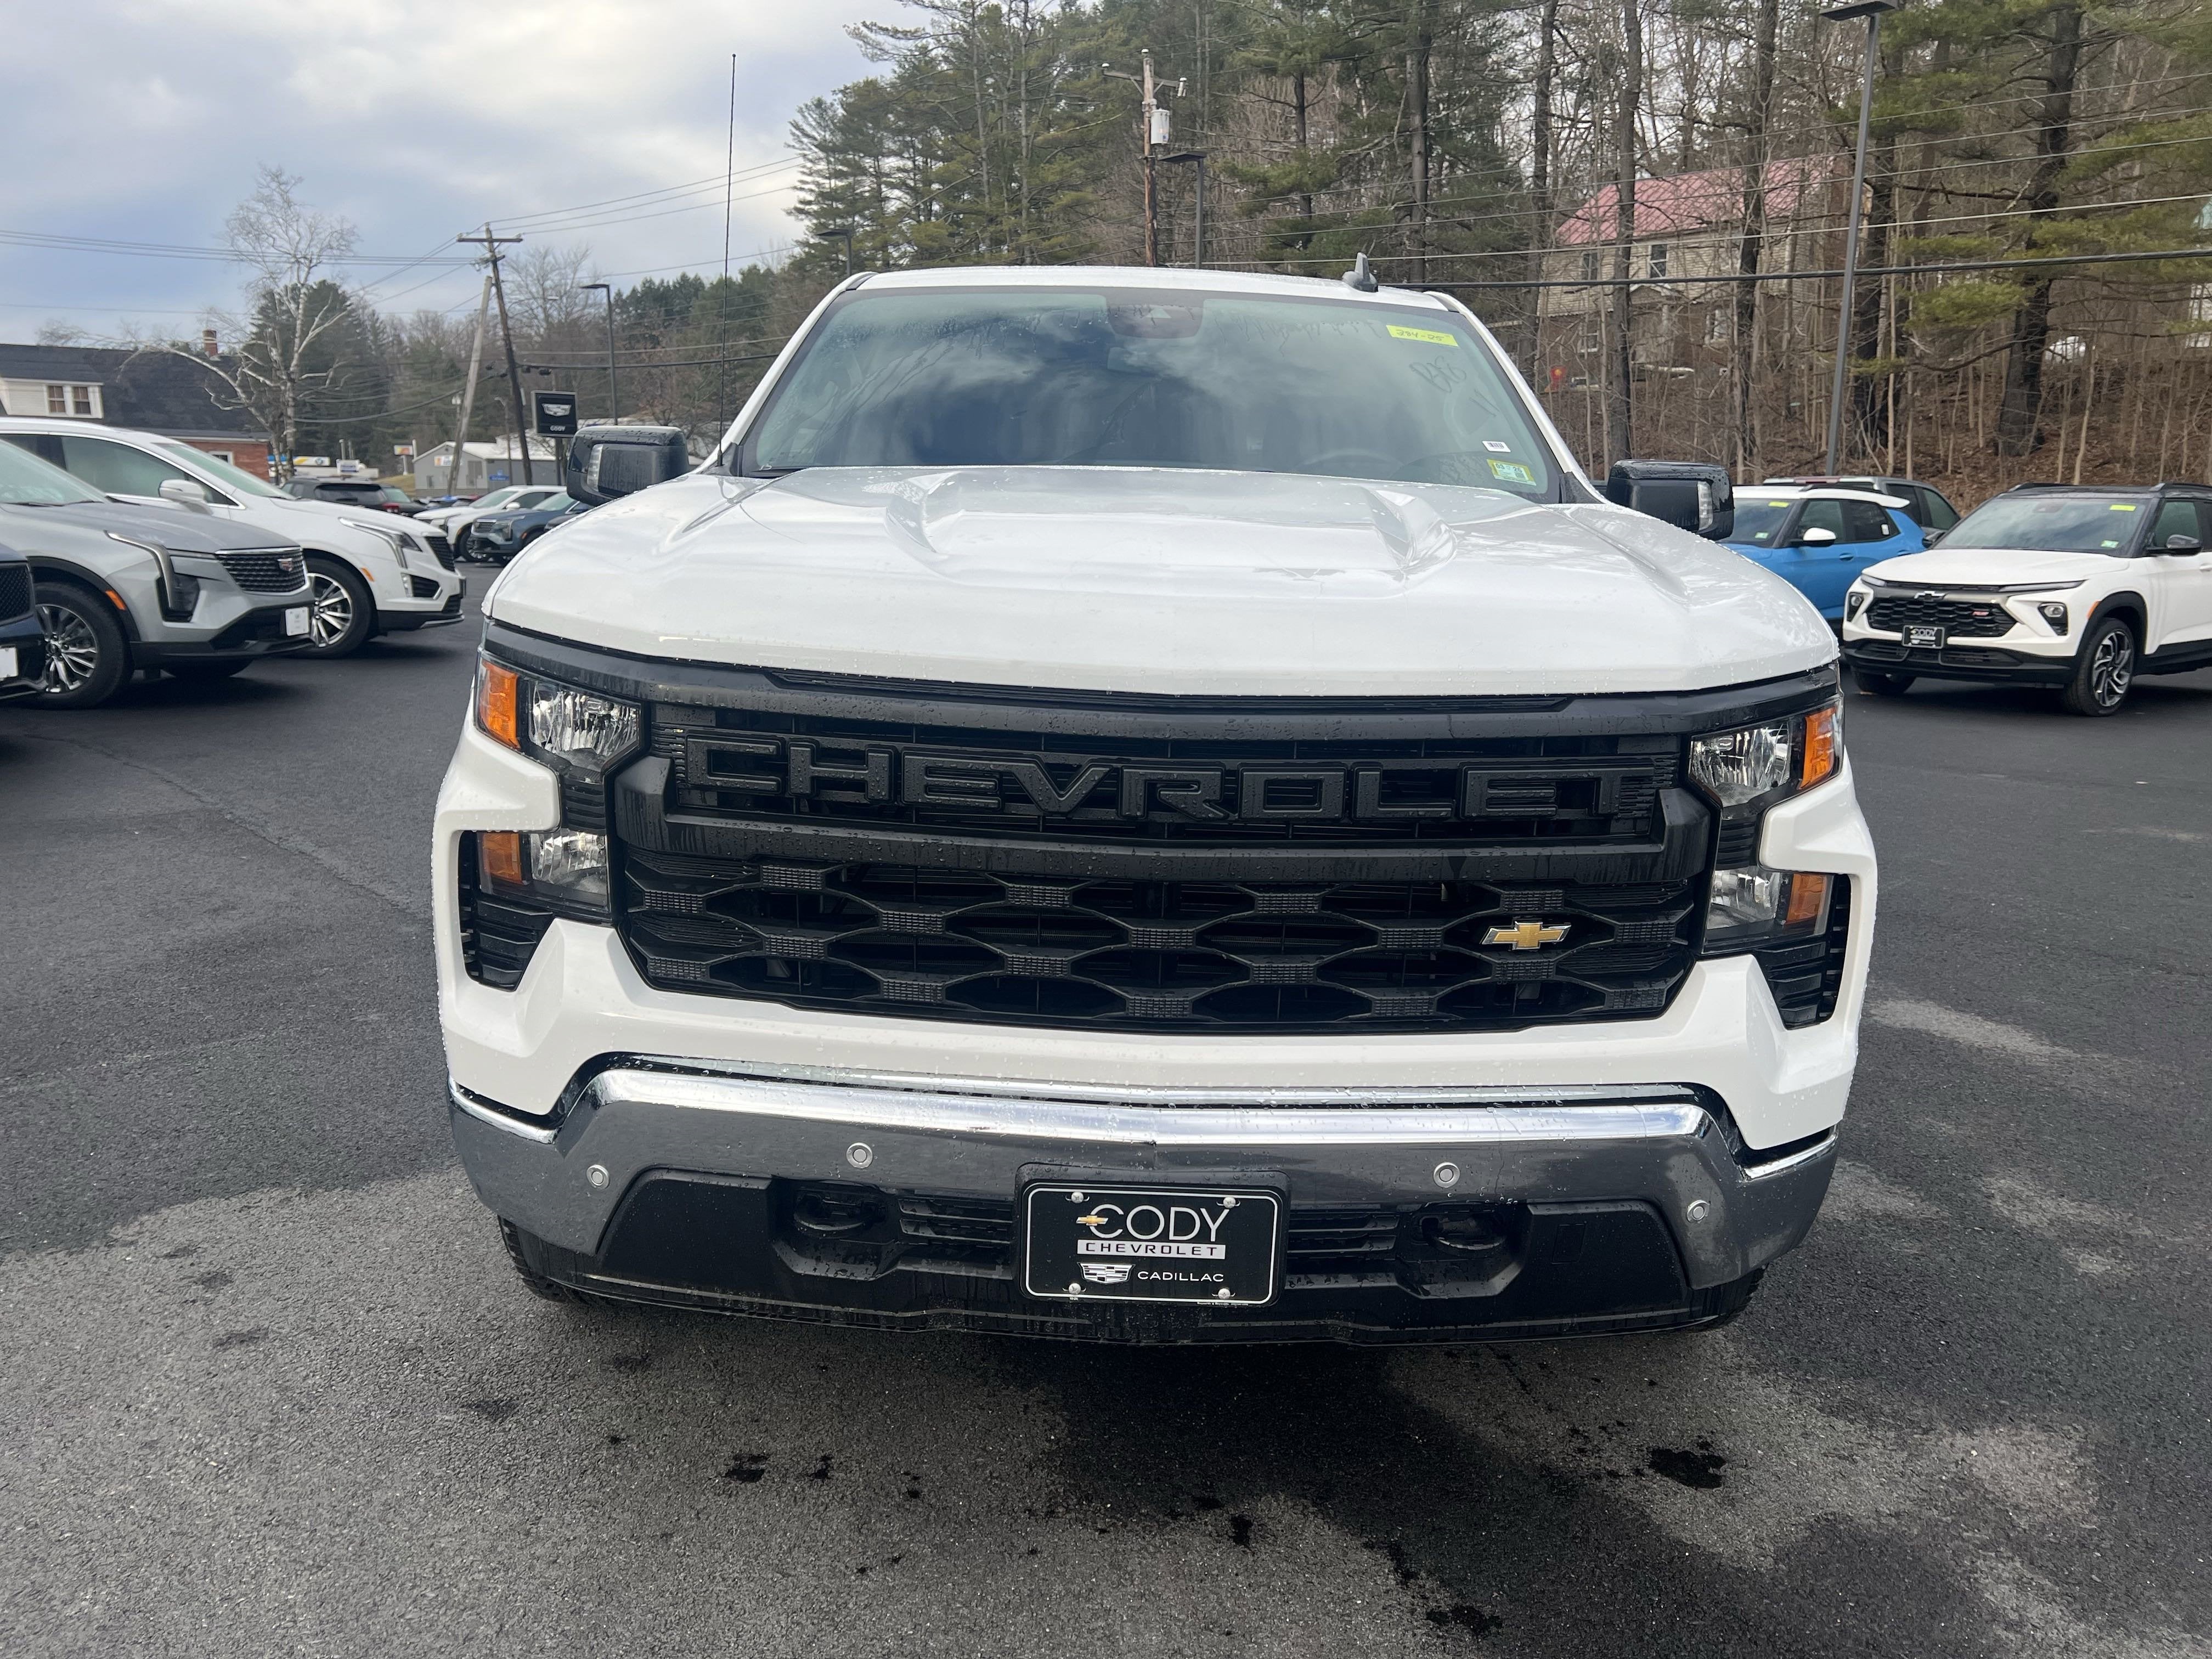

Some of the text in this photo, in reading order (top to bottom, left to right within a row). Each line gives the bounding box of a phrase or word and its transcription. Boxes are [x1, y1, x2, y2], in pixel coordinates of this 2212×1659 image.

[686, 733, 1655, 822] CHEVROLET
[1089, 1204, 1229, 1242] CODY
[1085, 1242, 1218, 1257] CHEVROLET
[1137, 1271, 1224, 1283] CADILLAC
